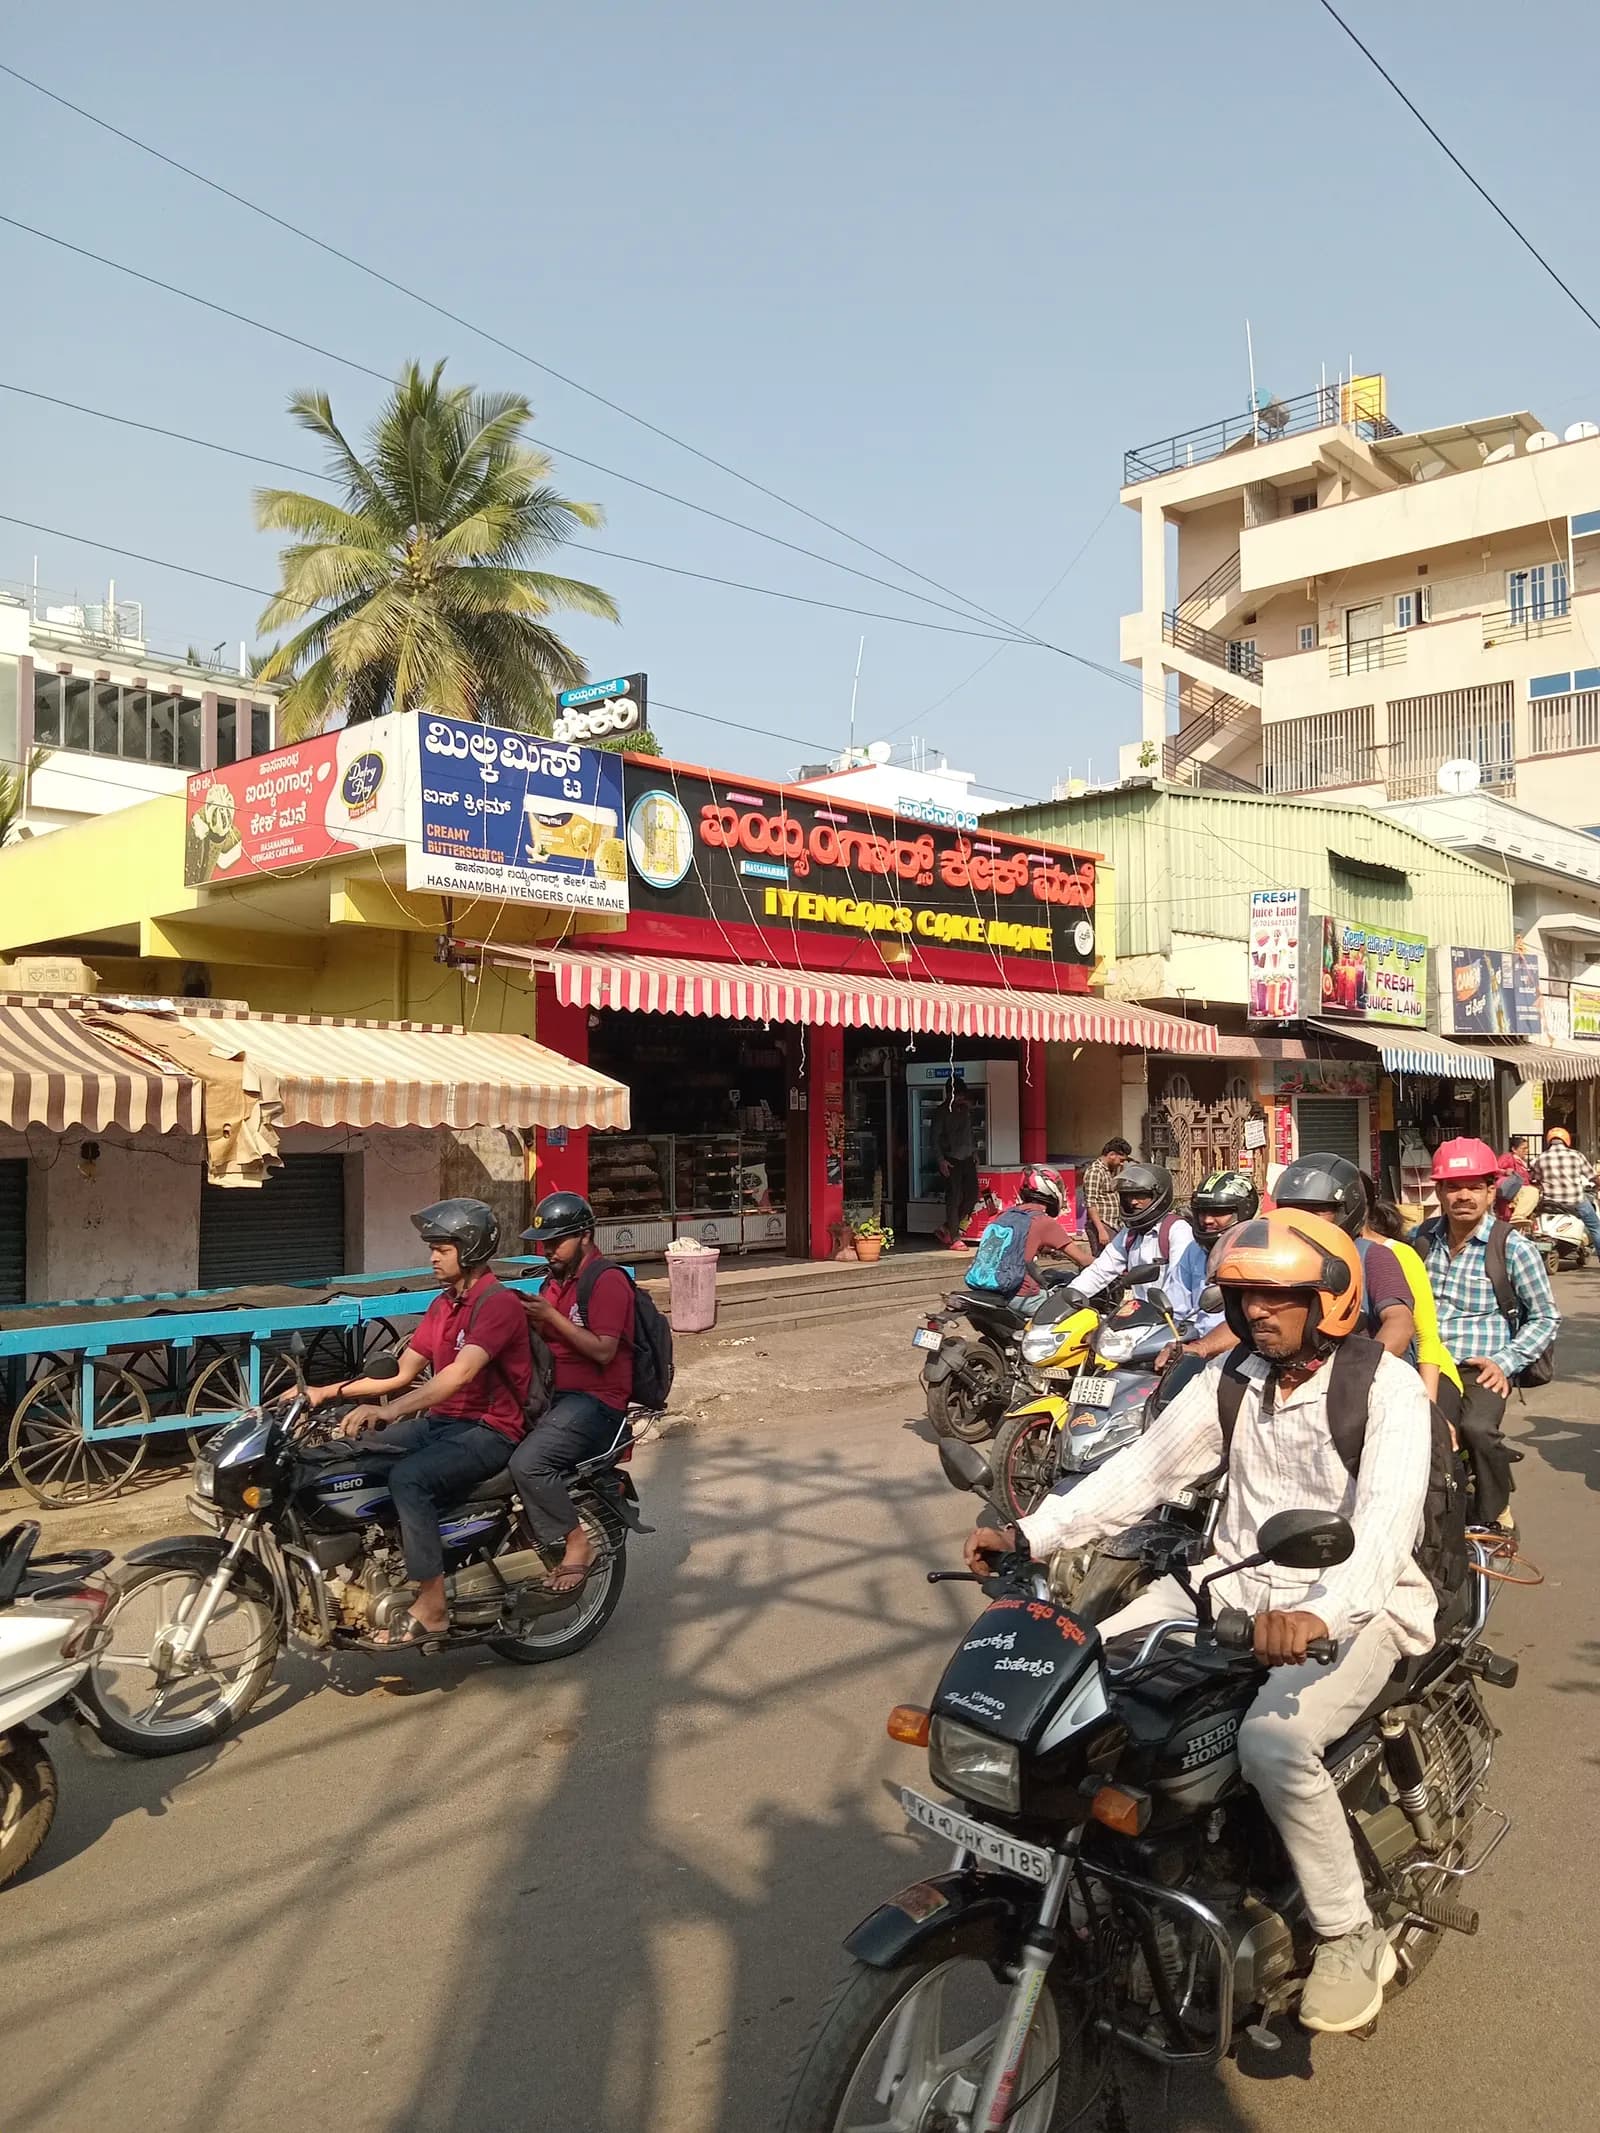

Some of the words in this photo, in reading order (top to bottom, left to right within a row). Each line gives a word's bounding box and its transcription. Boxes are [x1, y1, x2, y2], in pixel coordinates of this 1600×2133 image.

[423, 787, 460, 806] ಐಸ್
[426, 823, 470, 842] CREAMY
[427, 840, 504, 864] BUTTERSCOTCH
[427, 874, 508, 895] HASANAMBHA
[510, 886, 564, 904] IYENGERS
[566, 893, 594, 907] CAKE
[596, 897, 625, 911] MANE
[1253, 891, 1297, 904] FRESH
[1276, 906, 1297, 917] Land
[1376, 972, 1415, 992] FRESH
[1366, 995, 1393, 1012] JUICE
[1396, 999, 1422, 1015] LAND
[334, 1477, 363, 1491] Hero
[994, 1657, 1054, 1677] ಮಹೇಶ್ವರಿ
[1188, 1717, 1237, 1753] HERO
[1181, 1730, 1239, 1770] HOND
